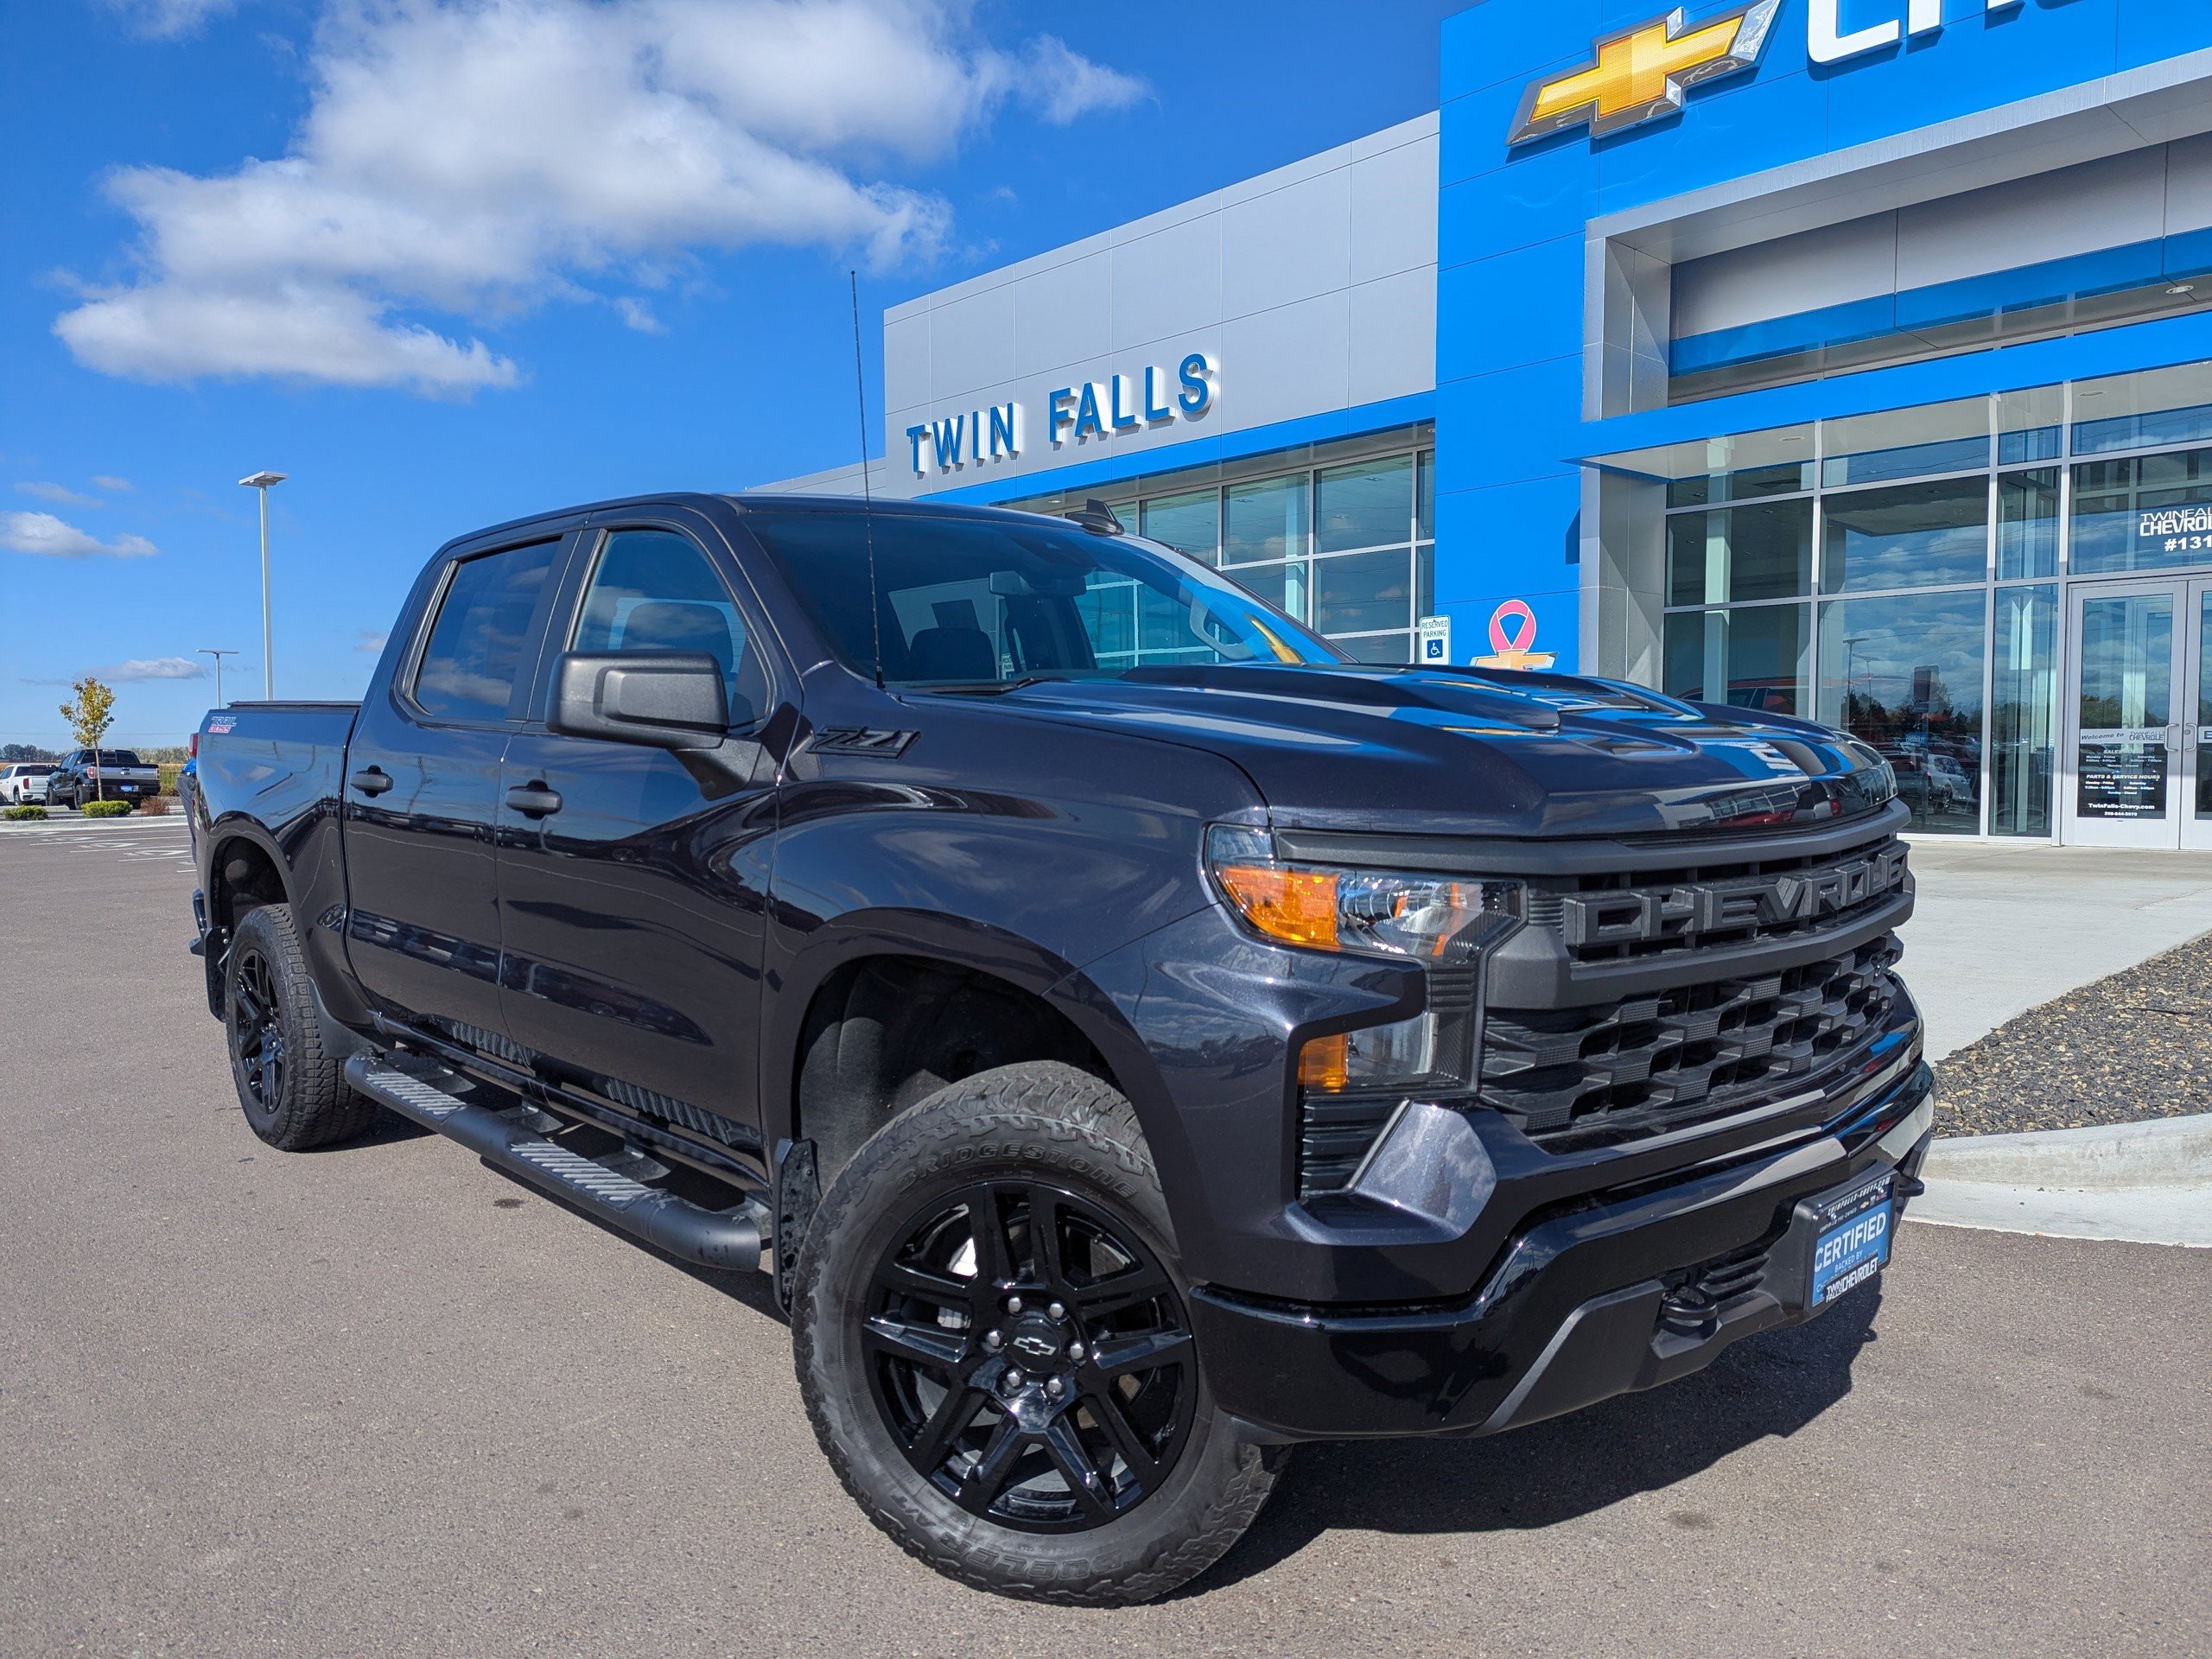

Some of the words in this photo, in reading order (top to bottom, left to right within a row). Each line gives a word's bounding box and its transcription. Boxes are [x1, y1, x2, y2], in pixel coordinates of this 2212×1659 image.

[906, 402, 1020, 474] TWIN
[1048, 353, 1217, 444] FALLS
[1421, 620, 1448, 629] RESERVED
[1423, 629, 1446, 639] PARKING
[897, 1140, 1138, 1198] BRIDGESTONE
[1814, 1211, 1887, 1273] CERTIFIED
[1834, 1255, 1855, 1273] BACKED
[1855, 1249, 1863, 1261] BY
[1826, 1279, 1843, 1297] TWIN
[1841, 1257, 1878, 1293] CHEVROLET
[1826, 1287, 1843, 1303] FALLS
[938, 1530, 1124, 1581] DUELER
